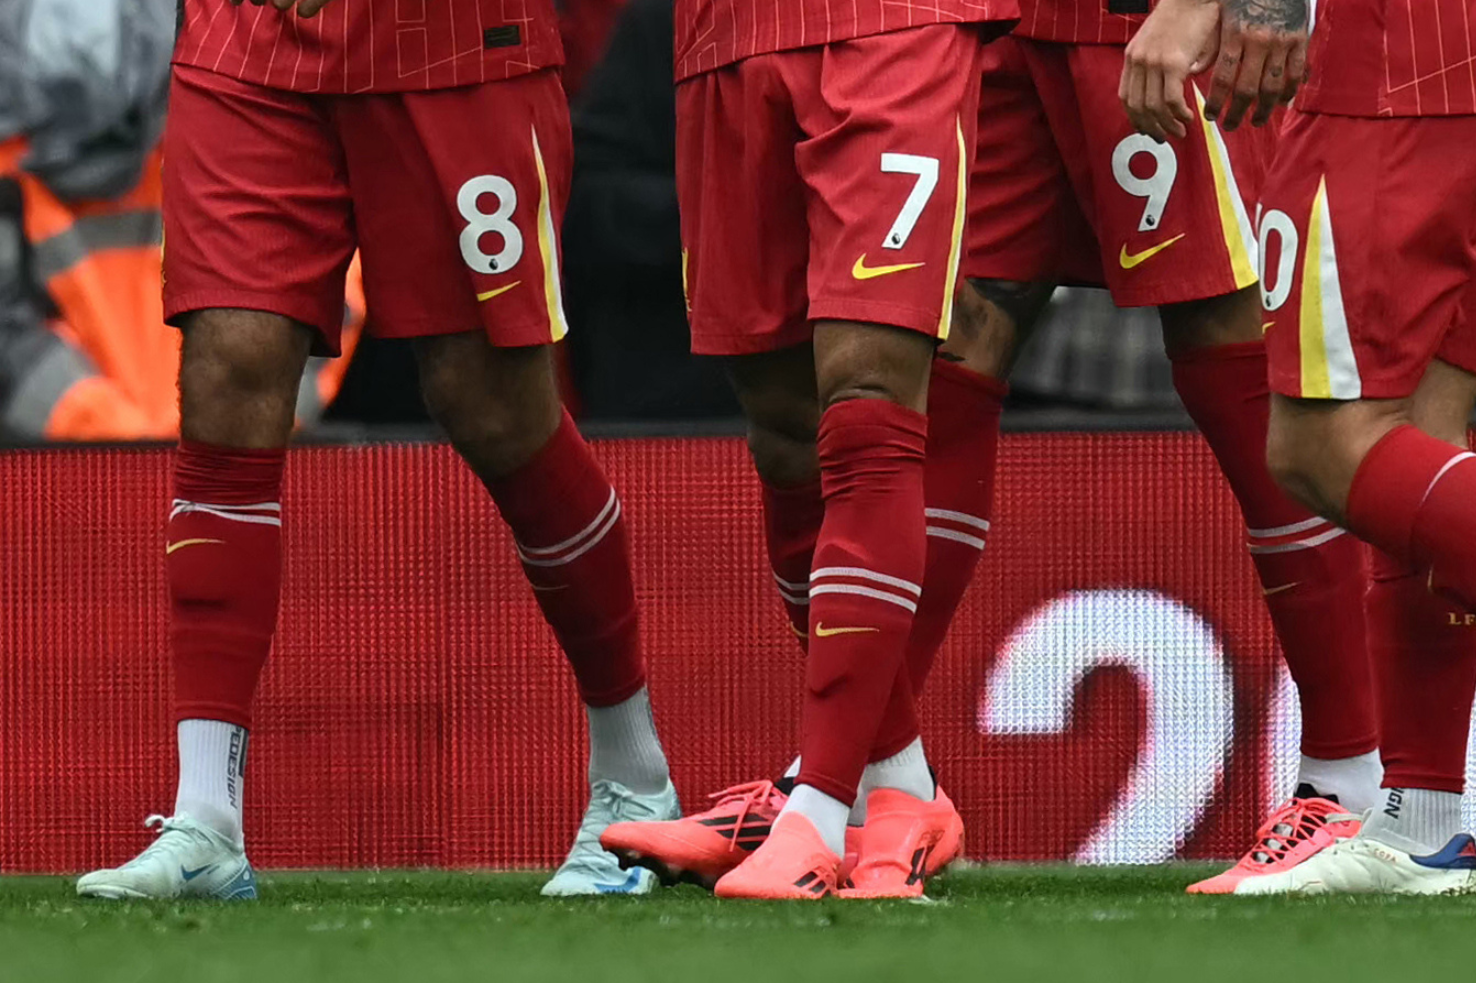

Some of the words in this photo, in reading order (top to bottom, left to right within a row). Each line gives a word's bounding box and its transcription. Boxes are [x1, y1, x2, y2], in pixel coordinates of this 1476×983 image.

[456, 174, 524, 275] 8
[880, 152, 940, 250] 7
[1112, 133, 1178, 233] 9
[1256, 202, 1299, 311] 0
[977, 587, 1302, 866] 2
